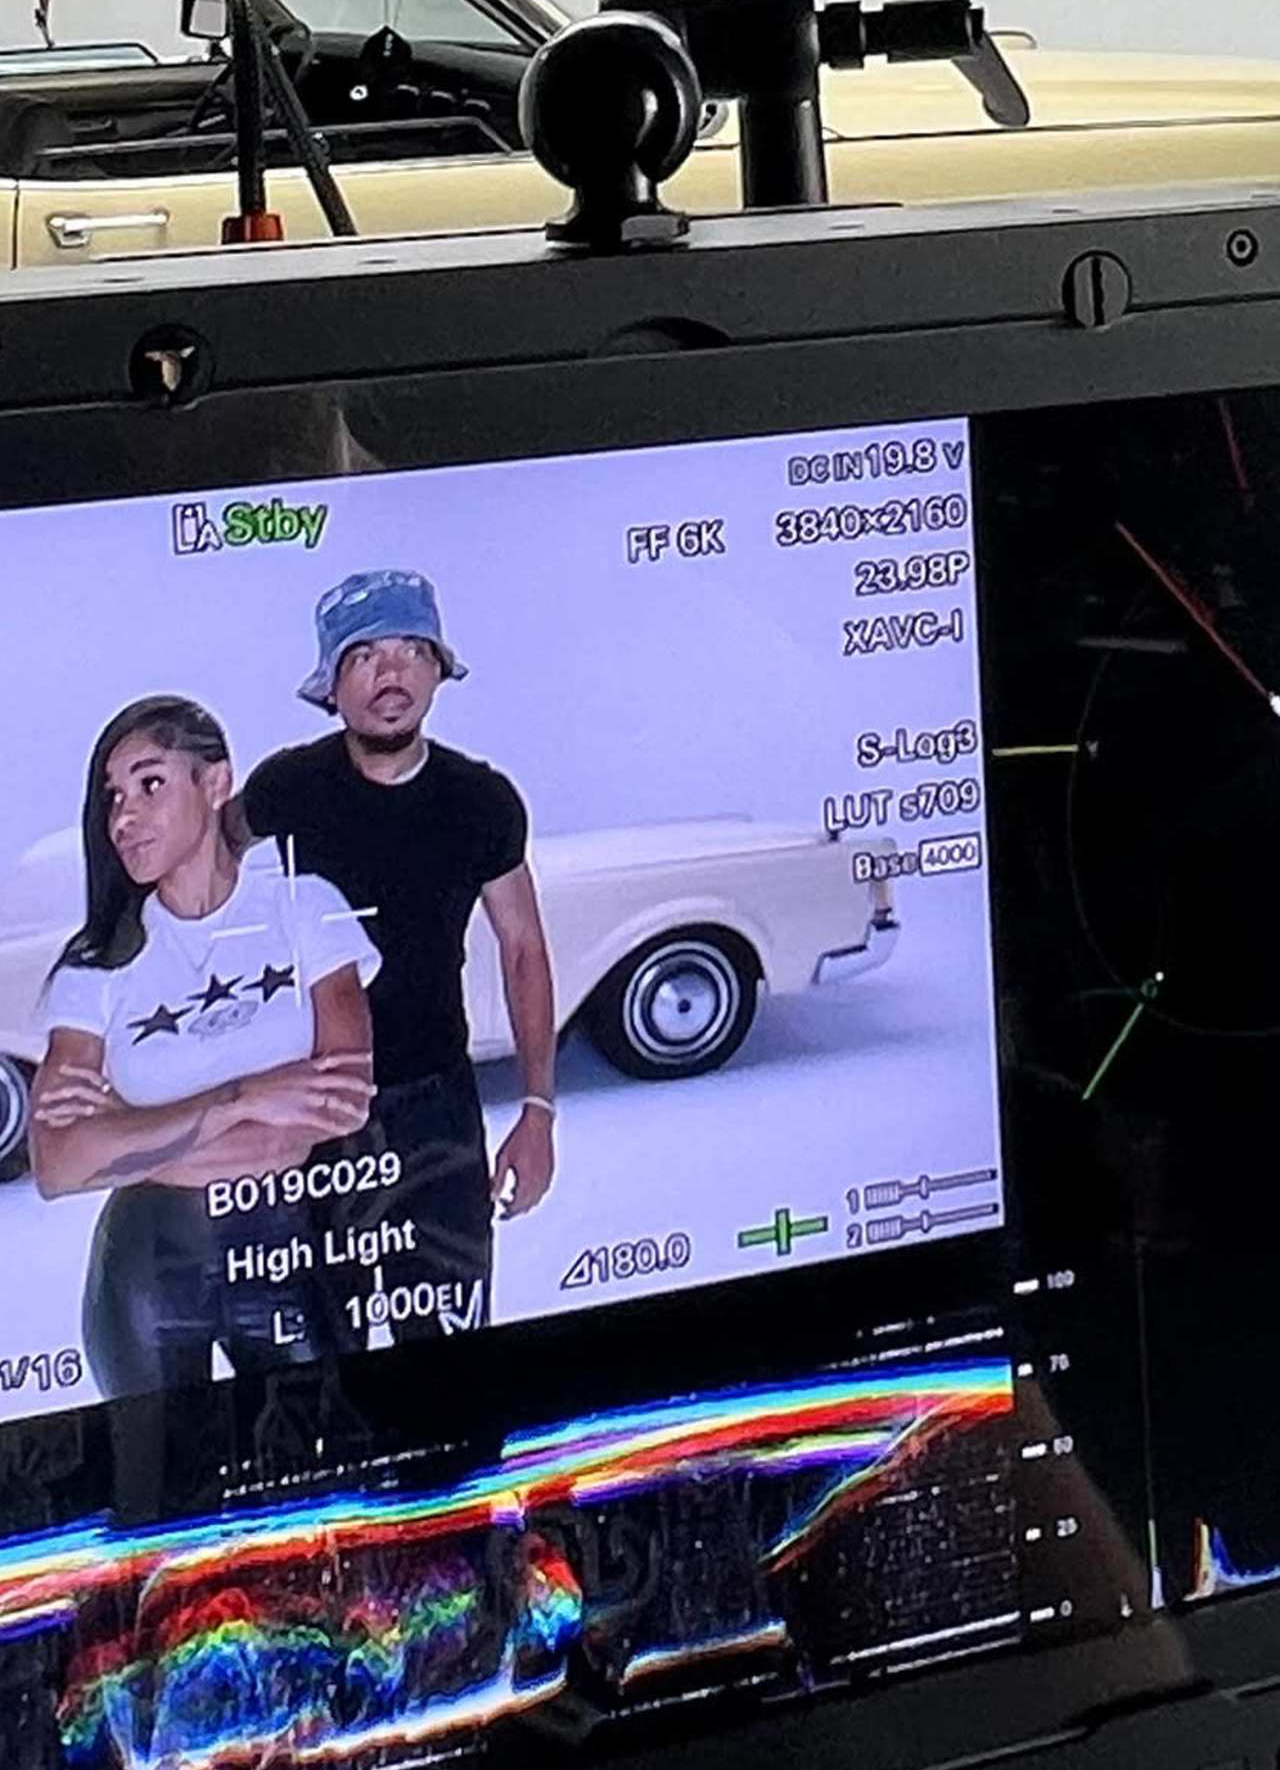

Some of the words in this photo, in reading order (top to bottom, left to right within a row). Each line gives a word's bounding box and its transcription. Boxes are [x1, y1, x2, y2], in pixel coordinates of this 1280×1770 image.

[222, 499, 328, 547] Stby
[627, 525, 669, 563] FF
[676, 519, 725, 557] 6K
[855, 552, 969, 595] 23.98P
[843, 609, 963, 656] XAVC-I
[857, 720, 977, 768] S-Log3
[824, 790, 892, 832] LUT
[899, 778, 980, 822] s709
[923, 841, 977, 867] 4000
[207, 1151, 403, 1218] B019C029
[226, 1236, 314, 1284] High
[324, 1219, 417, 1267] Light
